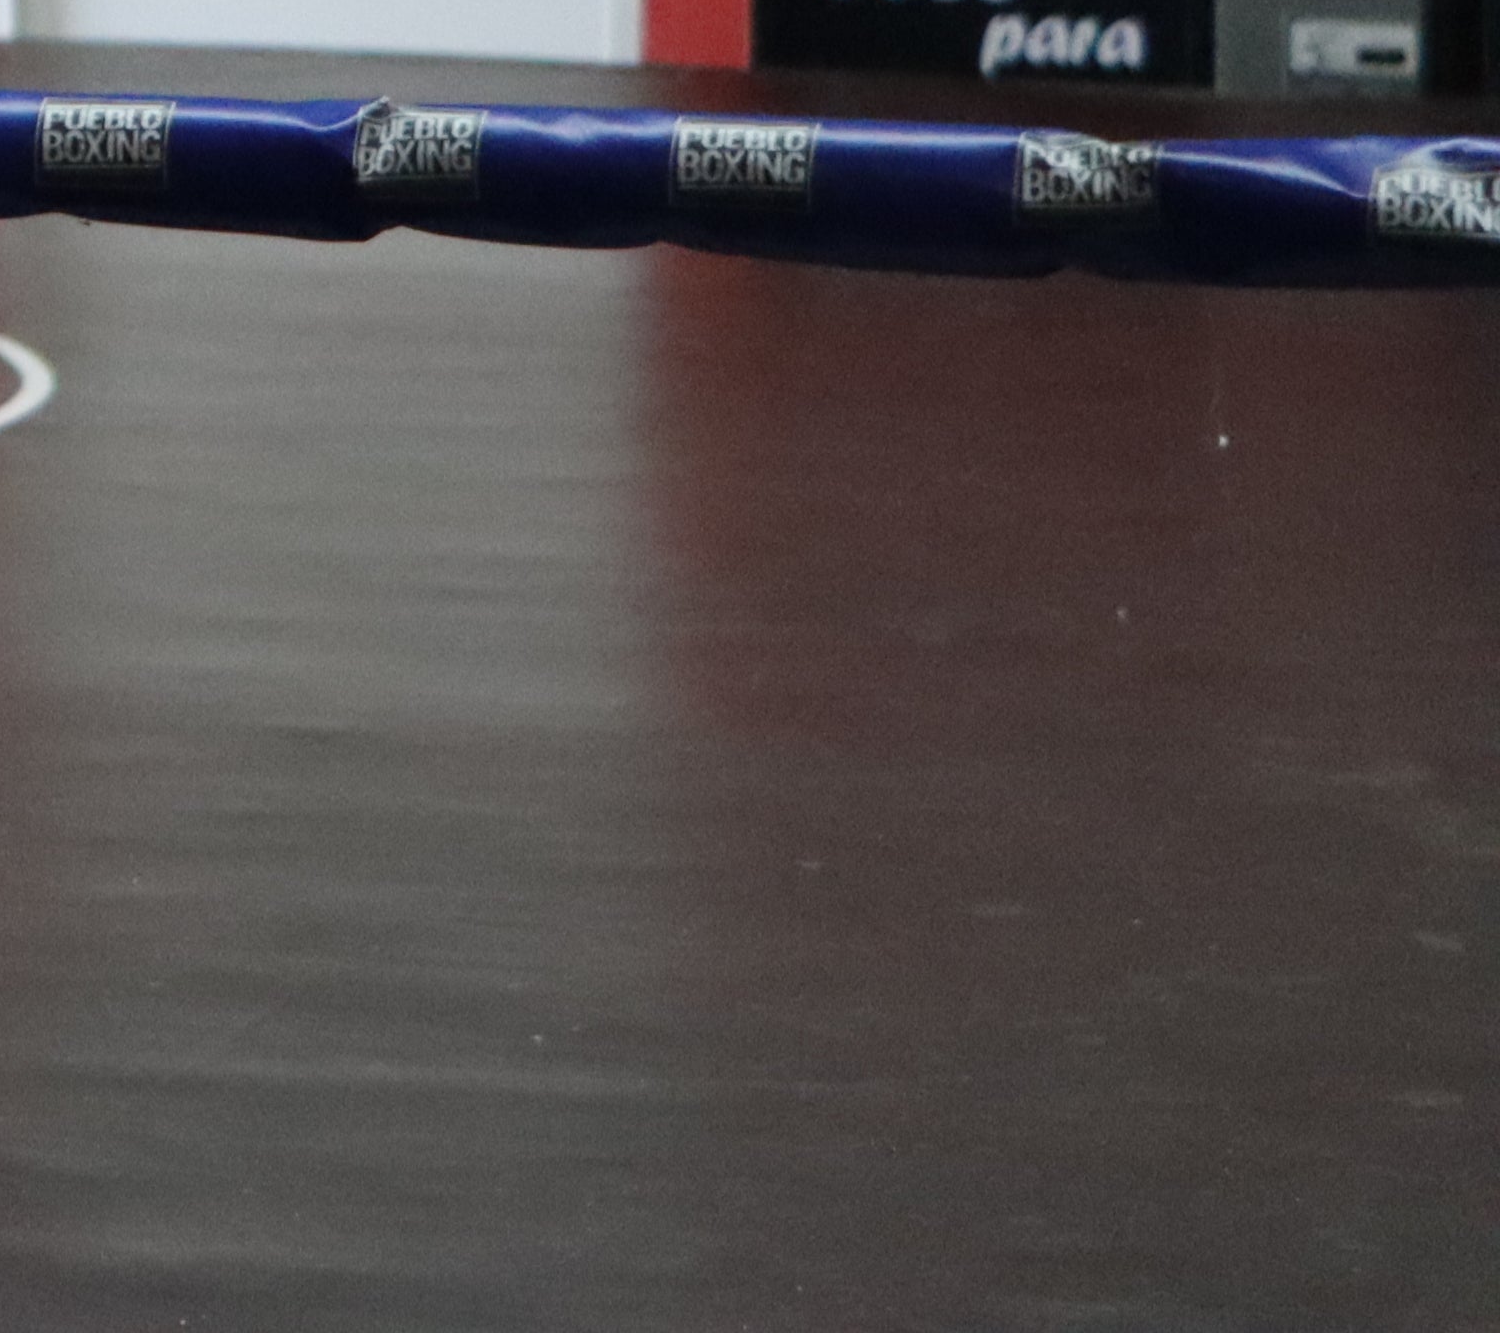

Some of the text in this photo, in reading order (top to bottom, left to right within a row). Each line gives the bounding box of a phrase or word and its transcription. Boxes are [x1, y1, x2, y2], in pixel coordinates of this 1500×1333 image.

[979, 8, 1150, 79] para
[46, 106, 160, 130] PUEBLO
[361, 117, 474, 141] PUEBLO
[44, 129, 159, 163] BOXING
[682, 129, 807, 152] PUEBLO
[361, 141, 471, 174] BOXING
[679, 152, 805, 183] BOXING
[1025, 168, 1152, 202] BOXING
